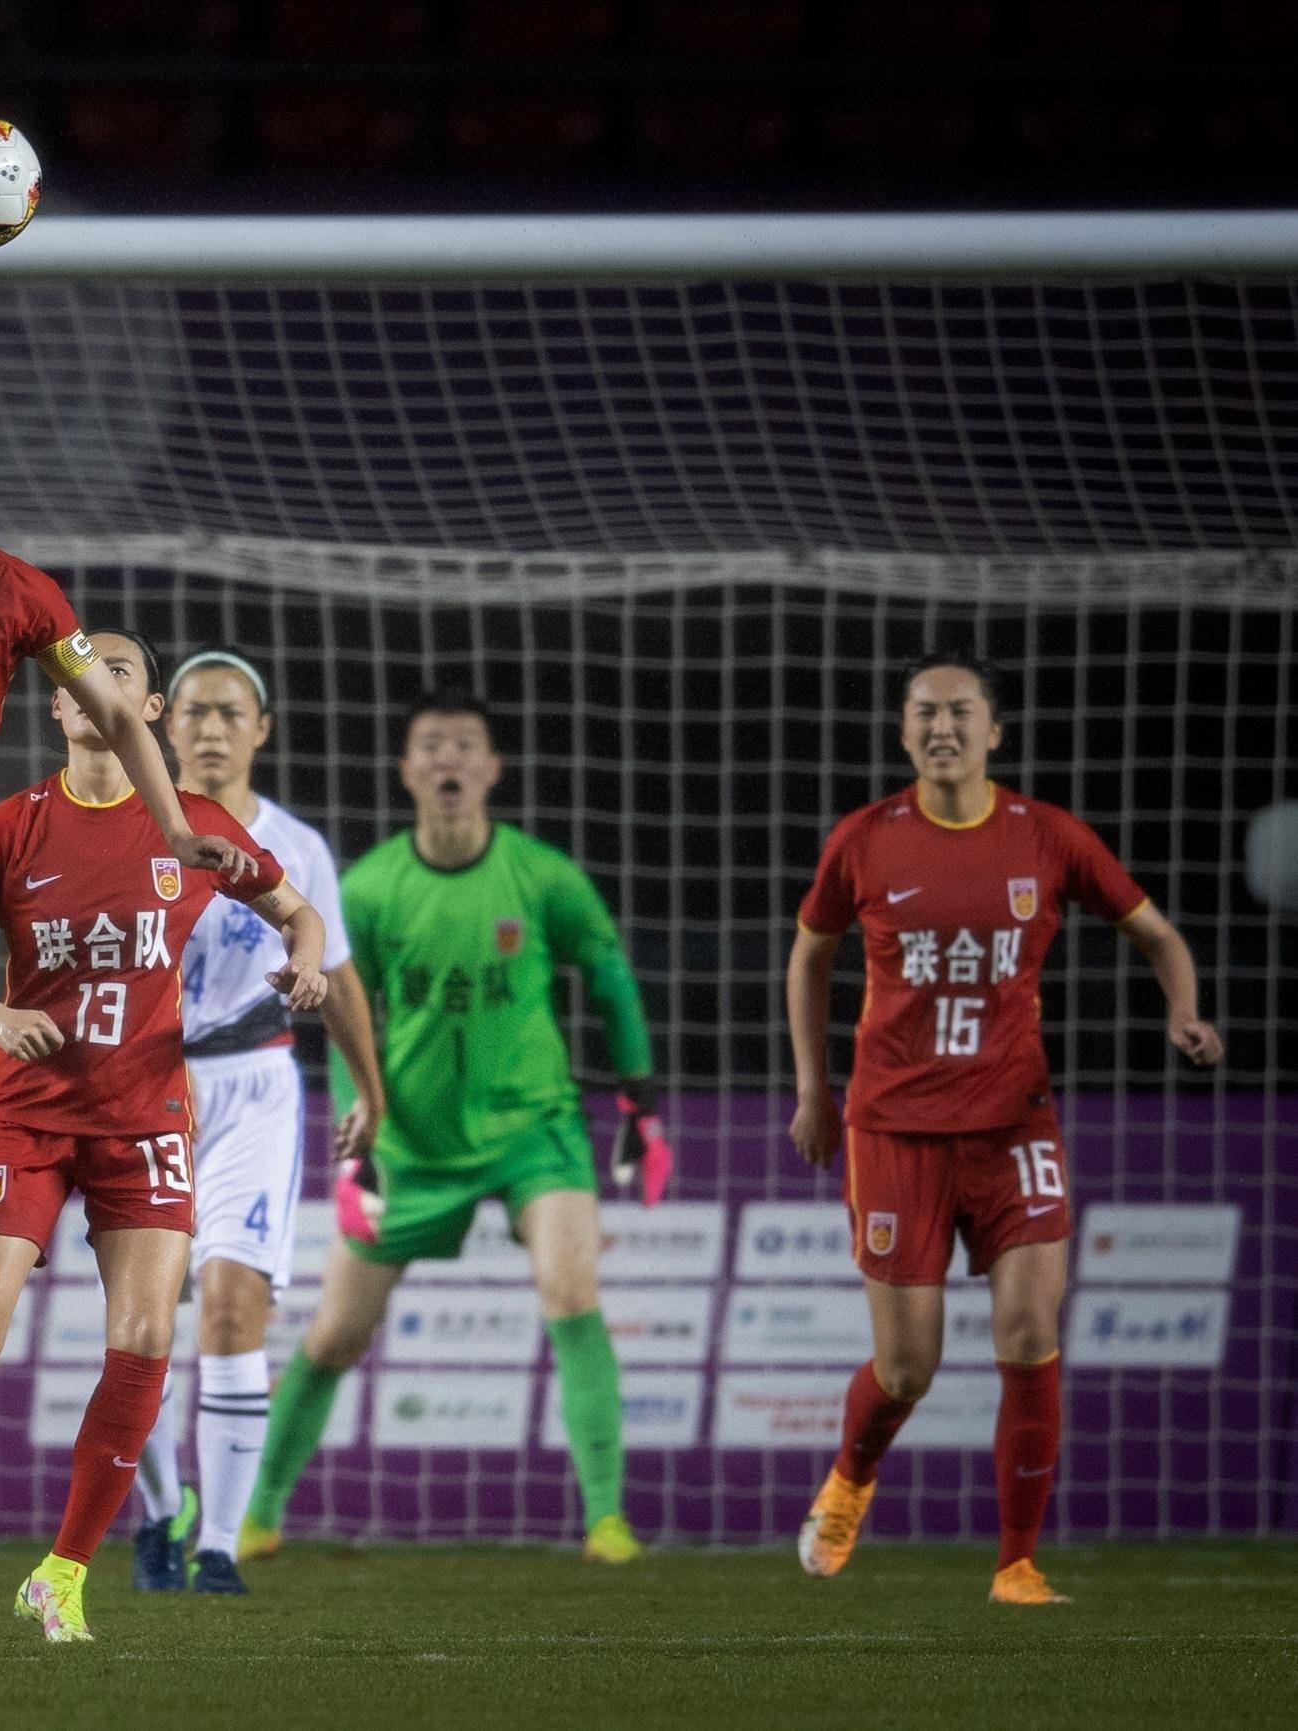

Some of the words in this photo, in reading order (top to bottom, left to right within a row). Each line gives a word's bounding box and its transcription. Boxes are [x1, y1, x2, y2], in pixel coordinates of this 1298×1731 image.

[31, 909, 172, 972] 联合队
[898, 927, 1022, 987] 联合队
[75, 982, 128, 1047] 13
[935, 996, 986, 1057] 16
[136, 1132, 192, 1194] 13
[1009, 1140, 1065, 1199] 16
[245, 1193, 269, 1242] 4
